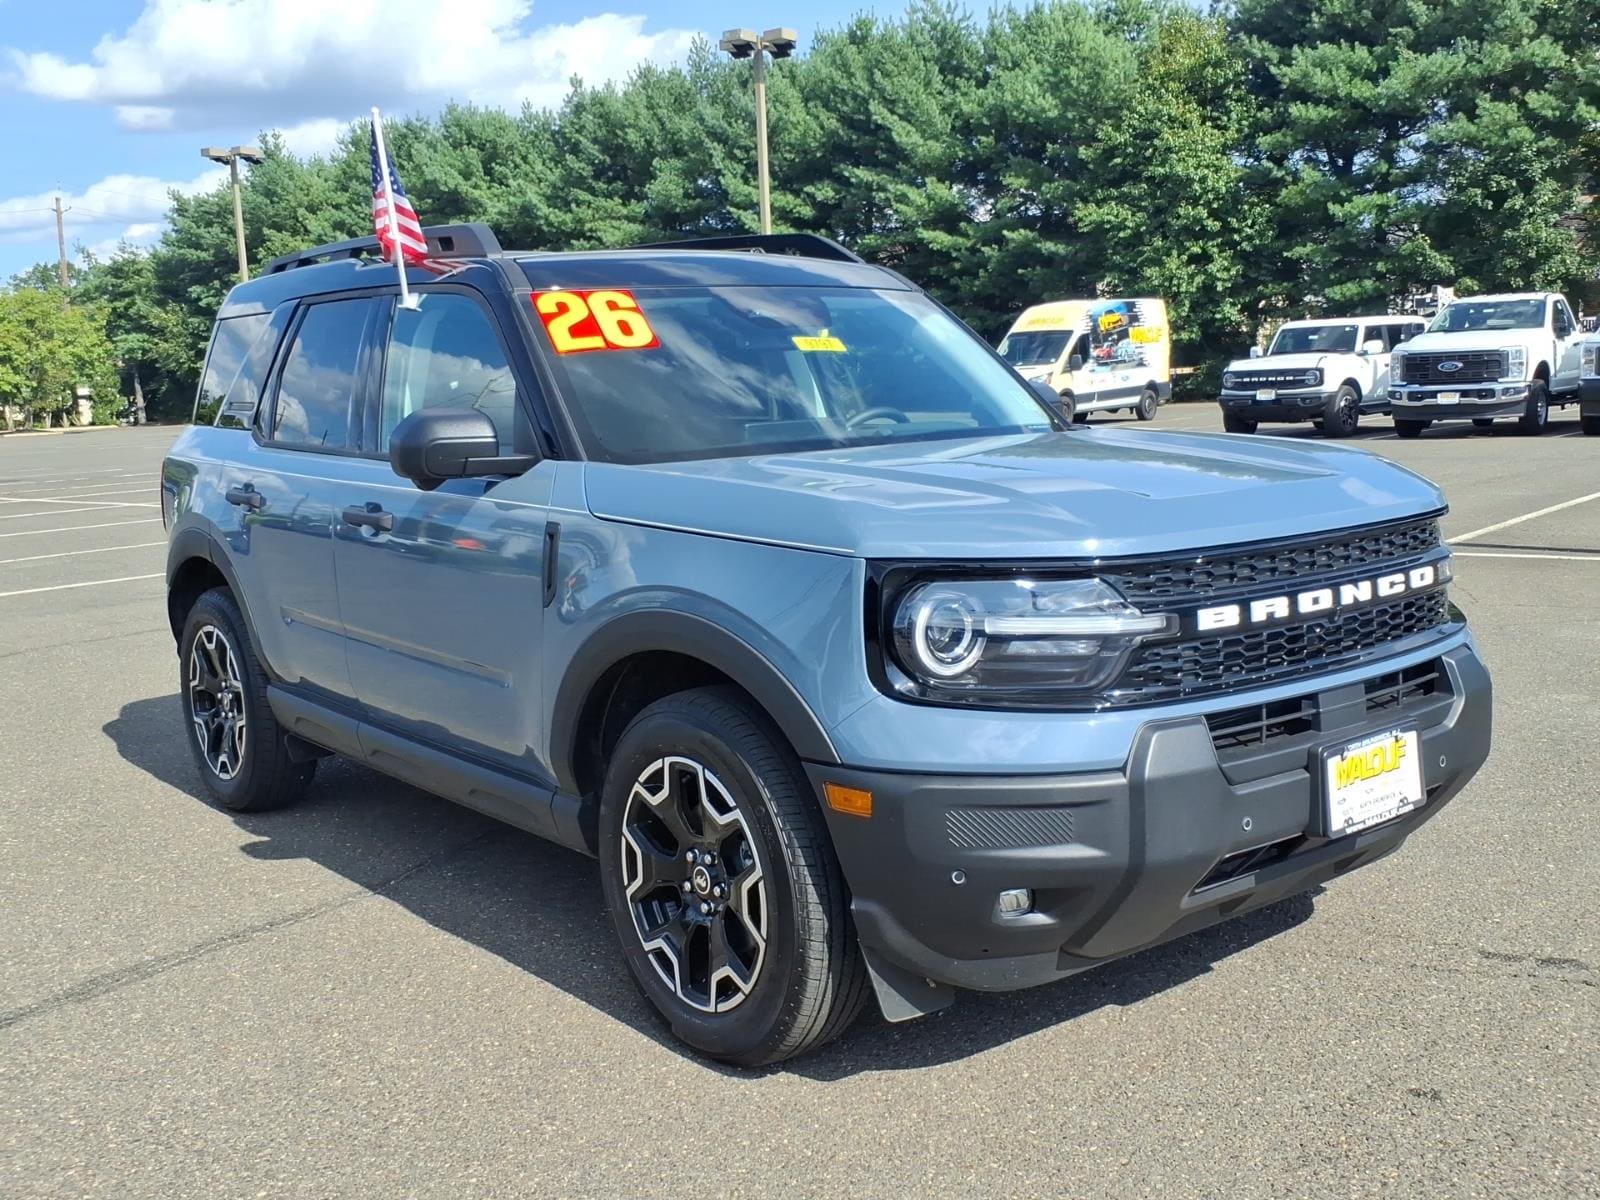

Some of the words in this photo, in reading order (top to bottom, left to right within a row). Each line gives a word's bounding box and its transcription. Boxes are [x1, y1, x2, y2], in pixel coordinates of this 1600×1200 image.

[537, 291, 654, 352] 26
[1197, 565, 1434, 631] BRONCO
[1335, 739, 1407, 790] MALOUF
